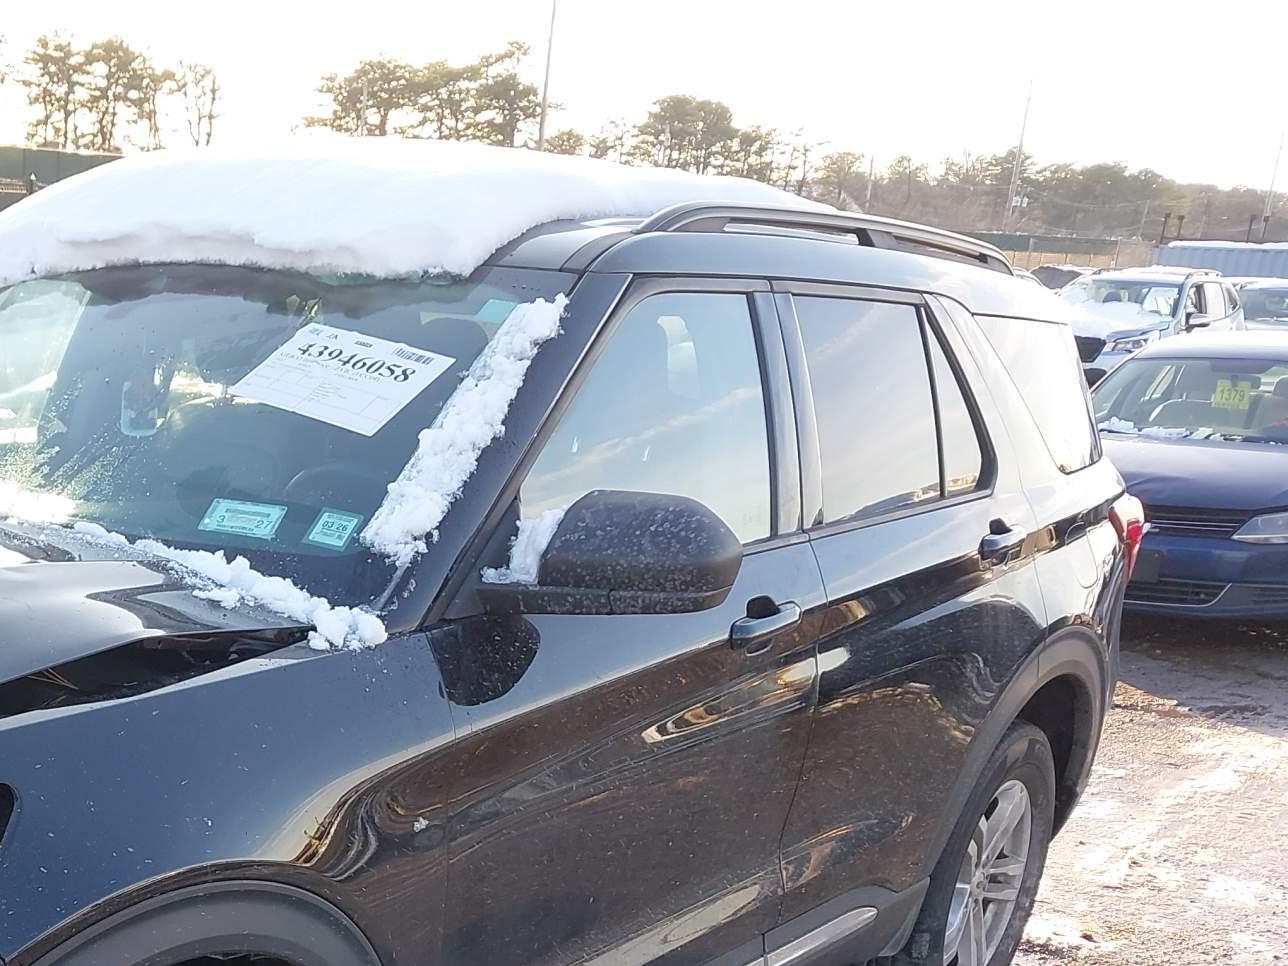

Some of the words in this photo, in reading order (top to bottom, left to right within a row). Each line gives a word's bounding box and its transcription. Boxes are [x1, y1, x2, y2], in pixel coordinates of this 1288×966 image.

[298, 343, 416, 382] 43946058
[216, 515, 226, 524] 3
[254, 520, 273, 529] 27
